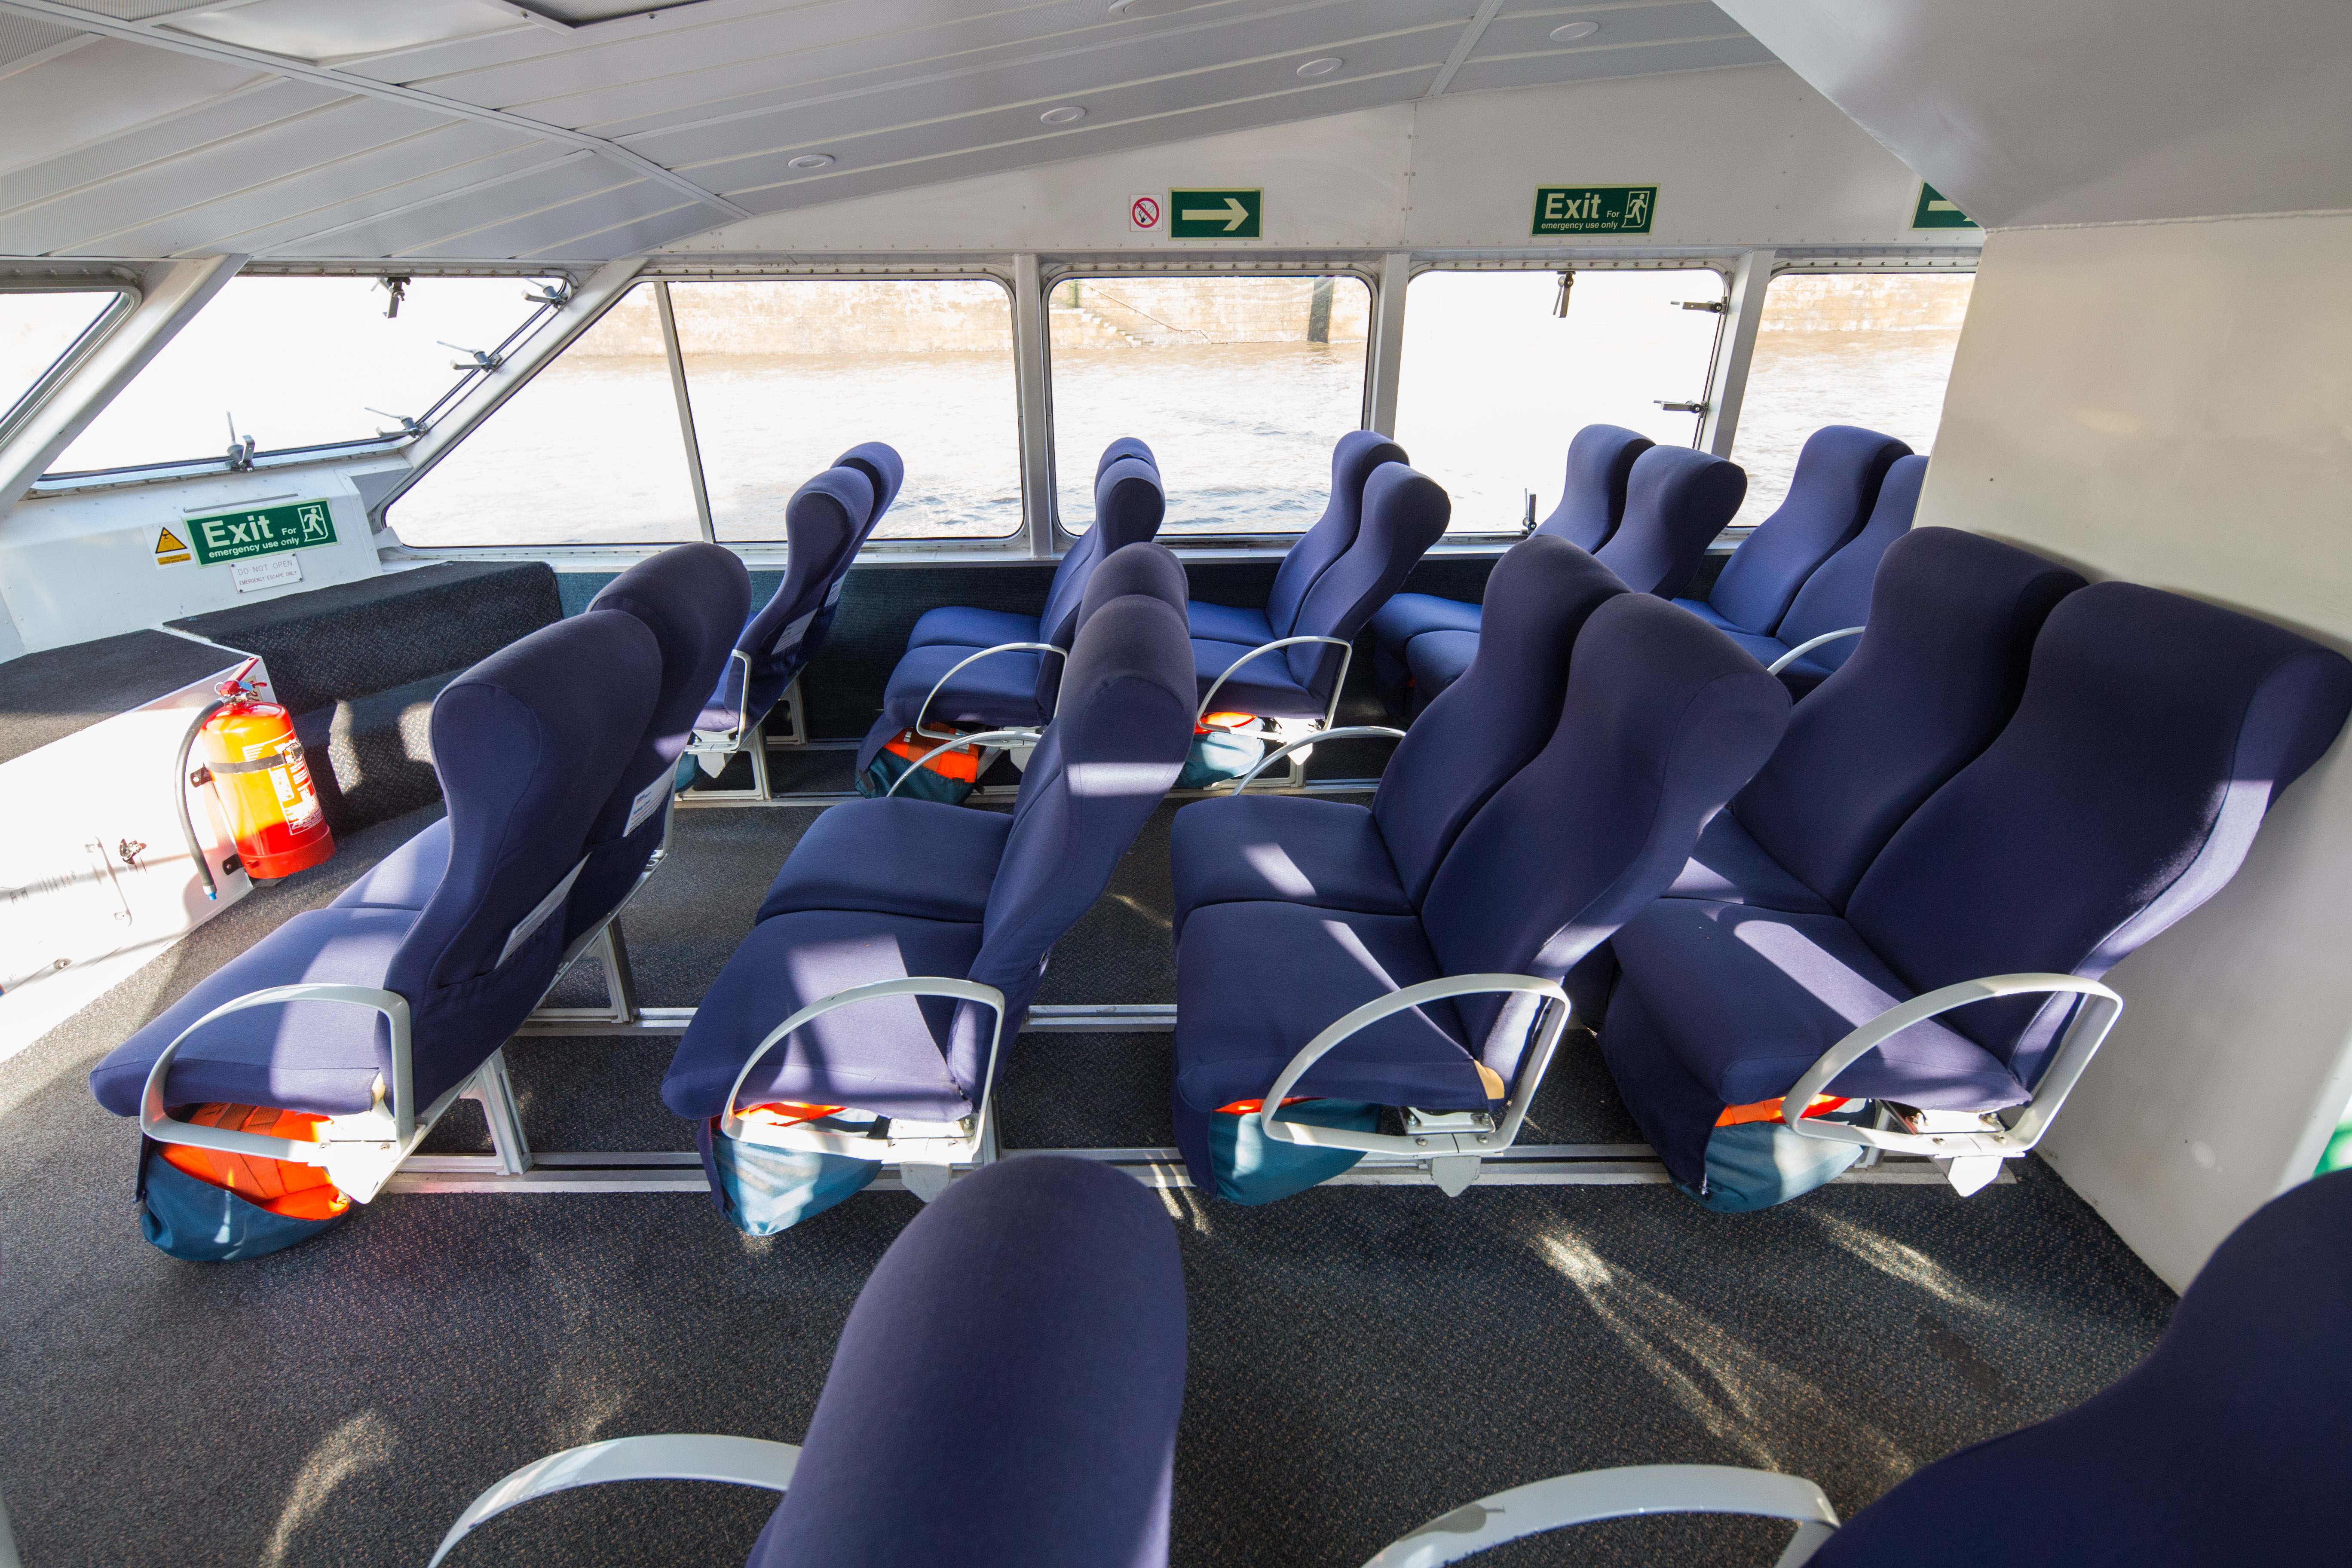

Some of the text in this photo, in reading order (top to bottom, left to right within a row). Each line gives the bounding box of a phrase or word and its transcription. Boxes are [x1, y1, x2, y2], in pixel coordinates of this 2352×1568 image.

[1545, 193, 1601, 219] Exit
[1541, 221, 1583, 230] emergency
[1601, 220, 1618, 230] only
[202, 515, 274, 548] Exit
[208, 544, 260, 558] emergency
[281, 537, 299, 545] only
[252, 564, 268, 573] NOT
[273, 560, 293, 569] OPEN
[239, 576, 265, 585] EMERGENCY
